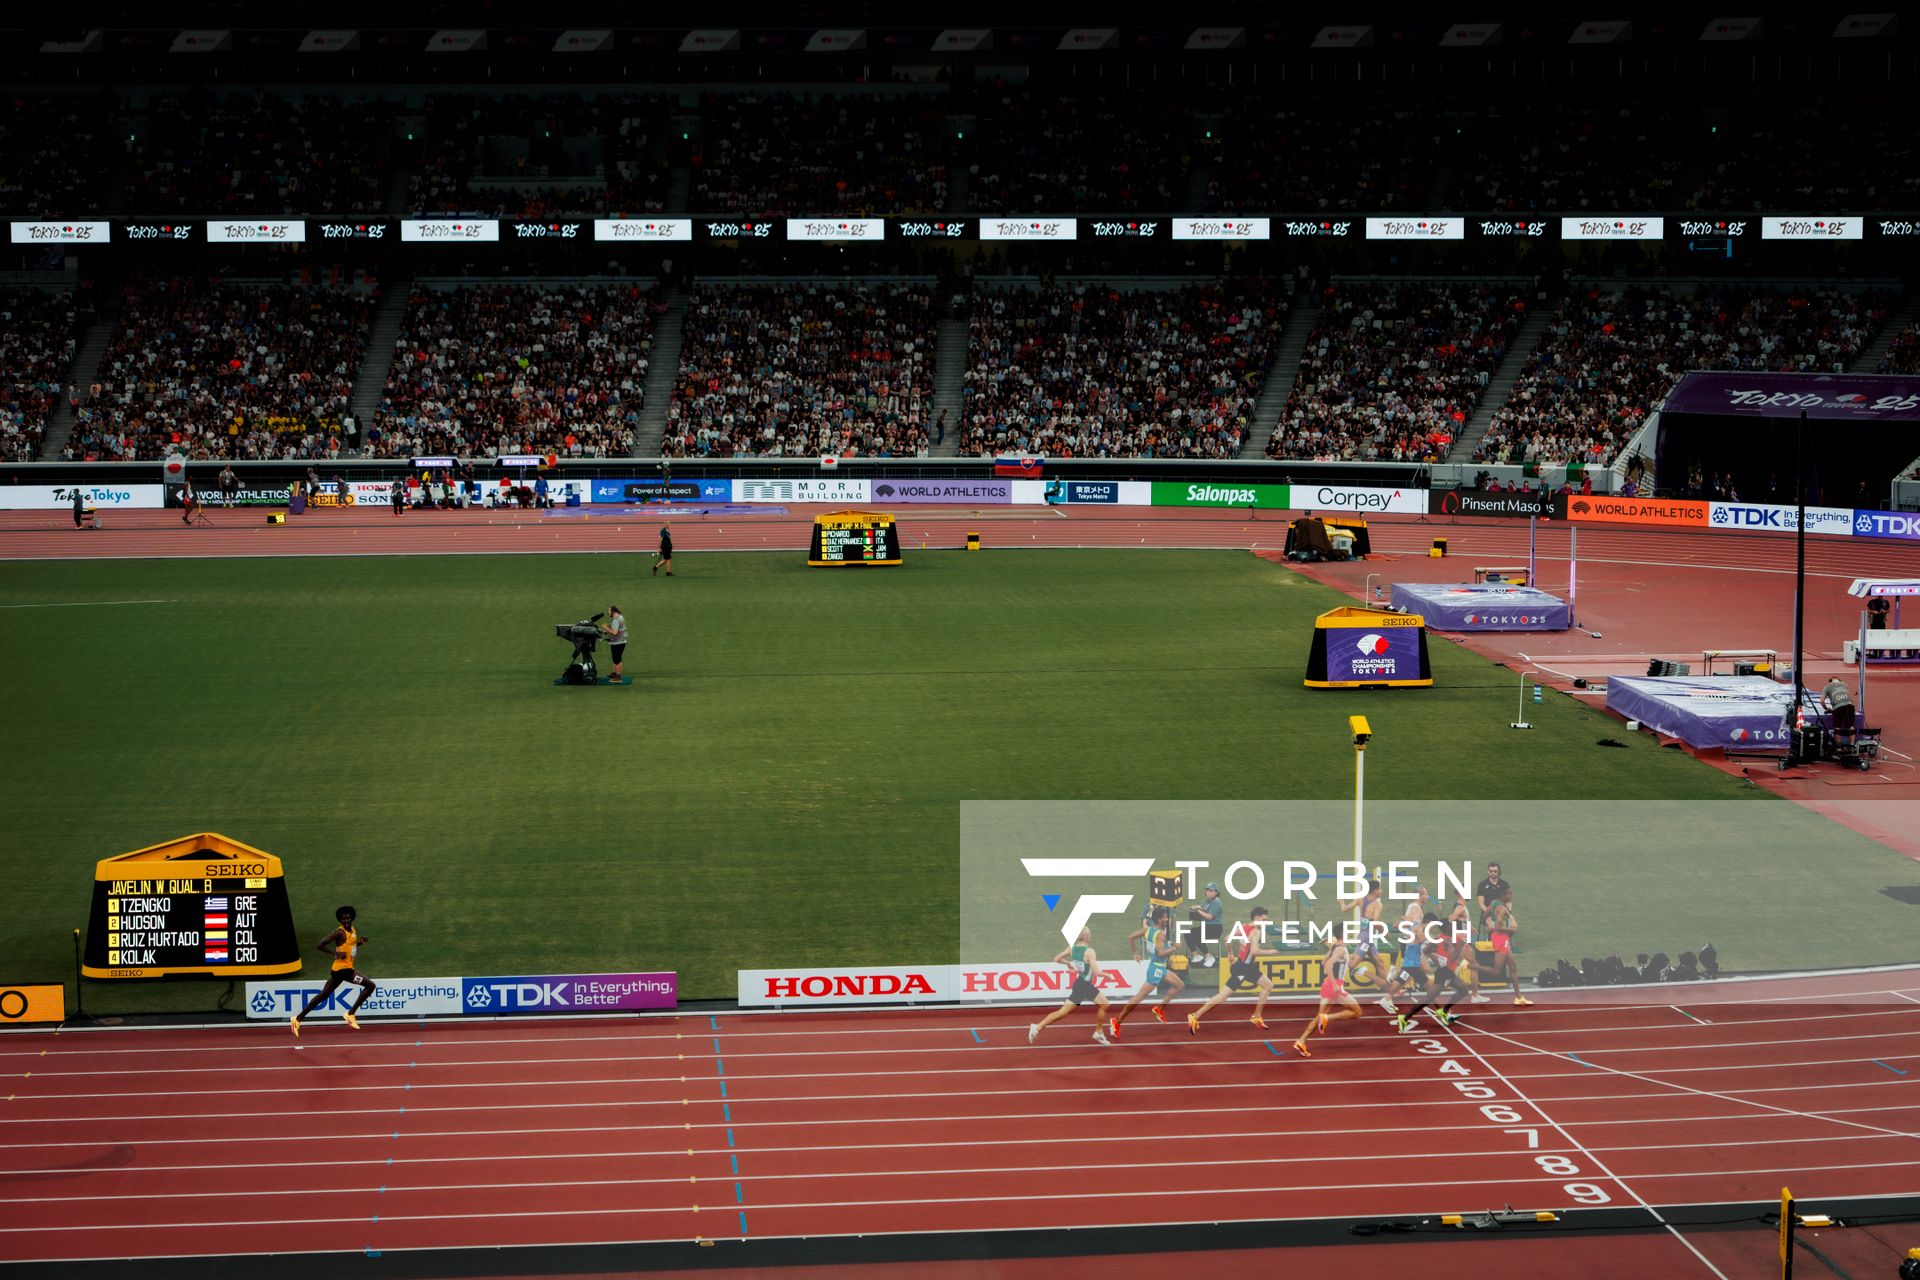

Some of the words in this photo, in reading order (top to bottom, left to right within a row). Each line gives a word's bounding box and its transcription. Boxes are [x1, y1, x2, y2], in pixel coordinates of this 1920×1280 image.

[28, 226, 59, 239] TOKYO
[76, 226, 93, 240] 25
[127, 225, 157, 238] TOKYO
[174, 225, 191, 239] 25
[225, 225, 255, 239] TOKYO
[272, 225, 289, 240] 25
[322, 225, 352, 238] TOKYO
[369, 225, 386, 238] 25
[419, 224, 449, 238] TOKYO
[466, 224, 482, 238] 25
[516, 224, 545, 237] TOKYO
[562, 224, 579, 238] 25
[612, 224, 642, 237] TOKYO
[659, 224, 675, 237] 25
[709, 223, 738, 236] TOKYO
[755, 223, 772, 237] 25
[805, 223, 835, 236] TOKYO
[851, 223, 867, 236] 25
[901, 223, 930, 236] TOKYO
[947, 223, 964, 236] 25
[997, 223, 1027, 236] TOKYO
[1044, 223, 1060, 236] 25
[1092, 222, 1123, 235] TOKYO
[1140, 222, 1157, 236] 25
[1190, 223, 1220, 235] TOKYO
[1237, 223, 1253, 236] 25
[1286, 222, 1316, 235] TOKYO
[1333, 222, 1350, 236] 25
[1384, 222, 1413, 235] TOKYO
[1430, 222, 1448, 236] 25
[1480, 222, 1511, 235] TOKYO
[1528, 222, 1546, 236] 25
[1579, 222, 1610, 235] TOKYO
[1629, 222, 1647, 236] 25
[1680, 221, 1711, 235] TOKYO
[1727, 221, 1746, 236] 25
[1778, 221, 1810, 235] TOKYO
[1828, 221, 1846, 236] 25
[1880, 221, 1912, 235] TOKYO
[1727, 389, 1824, 407] TOKYO
[1869, 393, 1920, 410] 25
[663, 487, 692, 496] Rspect
[798, 482, 862, 490] MORI
[899, 487, 941, 496] WORLD
[943, 487, 1006, 497] ATHLETICS
[1076, 486, 1110, 494] 東京メトロ
[52, 488, 91, 502] Toko
[91, 489, 130, 503] Tokyo
[235, 490, 290, 499] ATHLETICS
[358, 495, 392, 503] SON
[799, 492, 862, 500] BUILDING
[1317, 488, 1392, 511] Corpay
[1462, 497, 1505, 510] Pinsent
[1507, 499, 1555, 513] Masos
[1595, 504, 1638, 516] WORLD
[1640, 506, 1703, 519] ATHLETICS
[1728, 507, 1781, 527] TDK
[1784, 510, 1793, 519] In
[1794, 511, 1851, 523] Eerything,
[1872, 515, 1920, 535] TDK
[827, 545, 843, 553] SCOTT
[1382, 618, 1418, 626] SEIKO
[205, 864, 265, 876] SEIKO
[108, 880, 151, 895] JAVELIN
[156, 880, 164, 894] W
[169, 880, 200, 894] QUAL.
[204, 879, 212, 893] B
[121, 898, 171, 913] TZENGKO
[235, 896, 257, 911] GRE
[111, 919, 117, 927] 2
[121, 915, 165, 930] HUDSON
[235, 913, 257, 928] AUT
[111, 936, 117, 945] 3
[121, 932, 145, 947] RUIZ
[148, 931, 199, 947] HURTADO
[235, 930, 257, 945] COL
[111, 953, 117, 962] 4
[121, 949, 156, 964] KOLAK
[235, 947, 257, 962] CRO
[110, 969, 143, 977] SEIKO
[375, 985, 459, 1000] Everything,
[574, 982, 586, 993] In
[591, 980, 673, 996] Everything,
[764, 974, 937, 998] HONDA
[274, 987, 354, 1012] TDK
[490, 982, 570, 1007] TDK
[574, 994, 622, 1005] Better
[360, 999, 406, 1010] Better
[1409, 1038, 1448, 1054] 3
[1439, 1059, 1472, 1076] 4
[1452, 1081, 1496, 1099] 5
[1479, 1104, 1523, 1123] 6
[1503, 1128, 1539, 1148] 7
[1534, 1155, 1580, 1175] 8
[1563, 1182, 1611, 1204] 9
